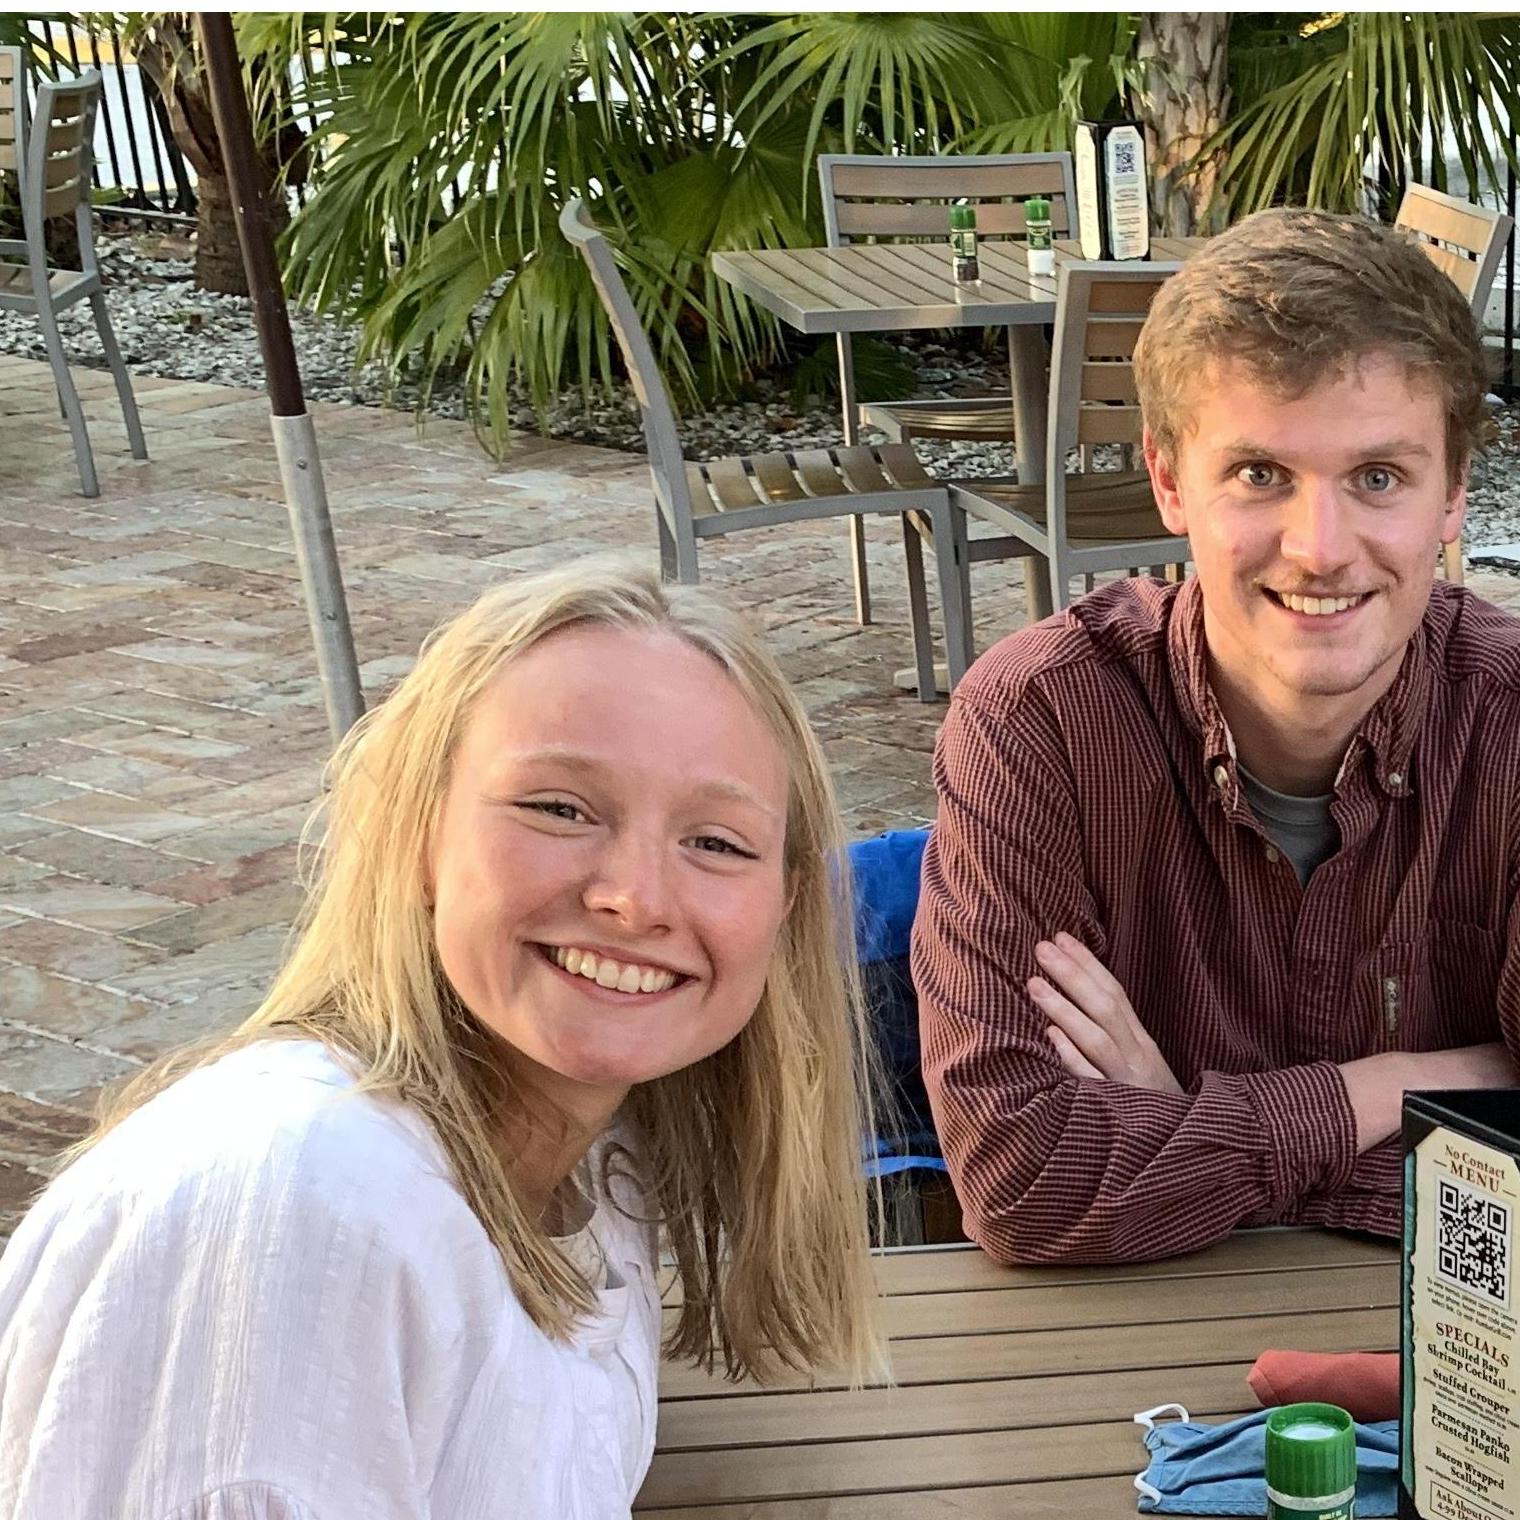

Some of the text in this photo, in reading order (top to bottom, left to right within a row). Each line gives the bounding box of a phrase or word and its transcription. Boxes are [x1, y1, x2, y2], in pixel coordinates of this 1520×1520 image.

[1445, 1144, 1505, 1180] No Contact
[1450, 1160, 1499, 1193] MENU
[1427, 1343, 1506, 1390] Shrimp Cocktail
[1435, 1322, 1510, 1368] SPECIALS
[1444, 1340, 1500, 1377] Chilled Bay
[1433, 1368, 1468, 1394] Stuffed
[1469, 1387, 1510, 1415] Grouper
[1431, 1416, 1510, 1464] Crusted Hogfish
[1432, 1403, 1478, 1436] Parmesan
[1480, 1429, 1510, 1452] Panko
[1435, 1446, 1505, 1490] Bacon Wrapped
[1450, 1466, 1488, 1494] Scallops
[1436, 1489, 1453, 1505] Ask
[1455, 1499, 1482, 1520] About
